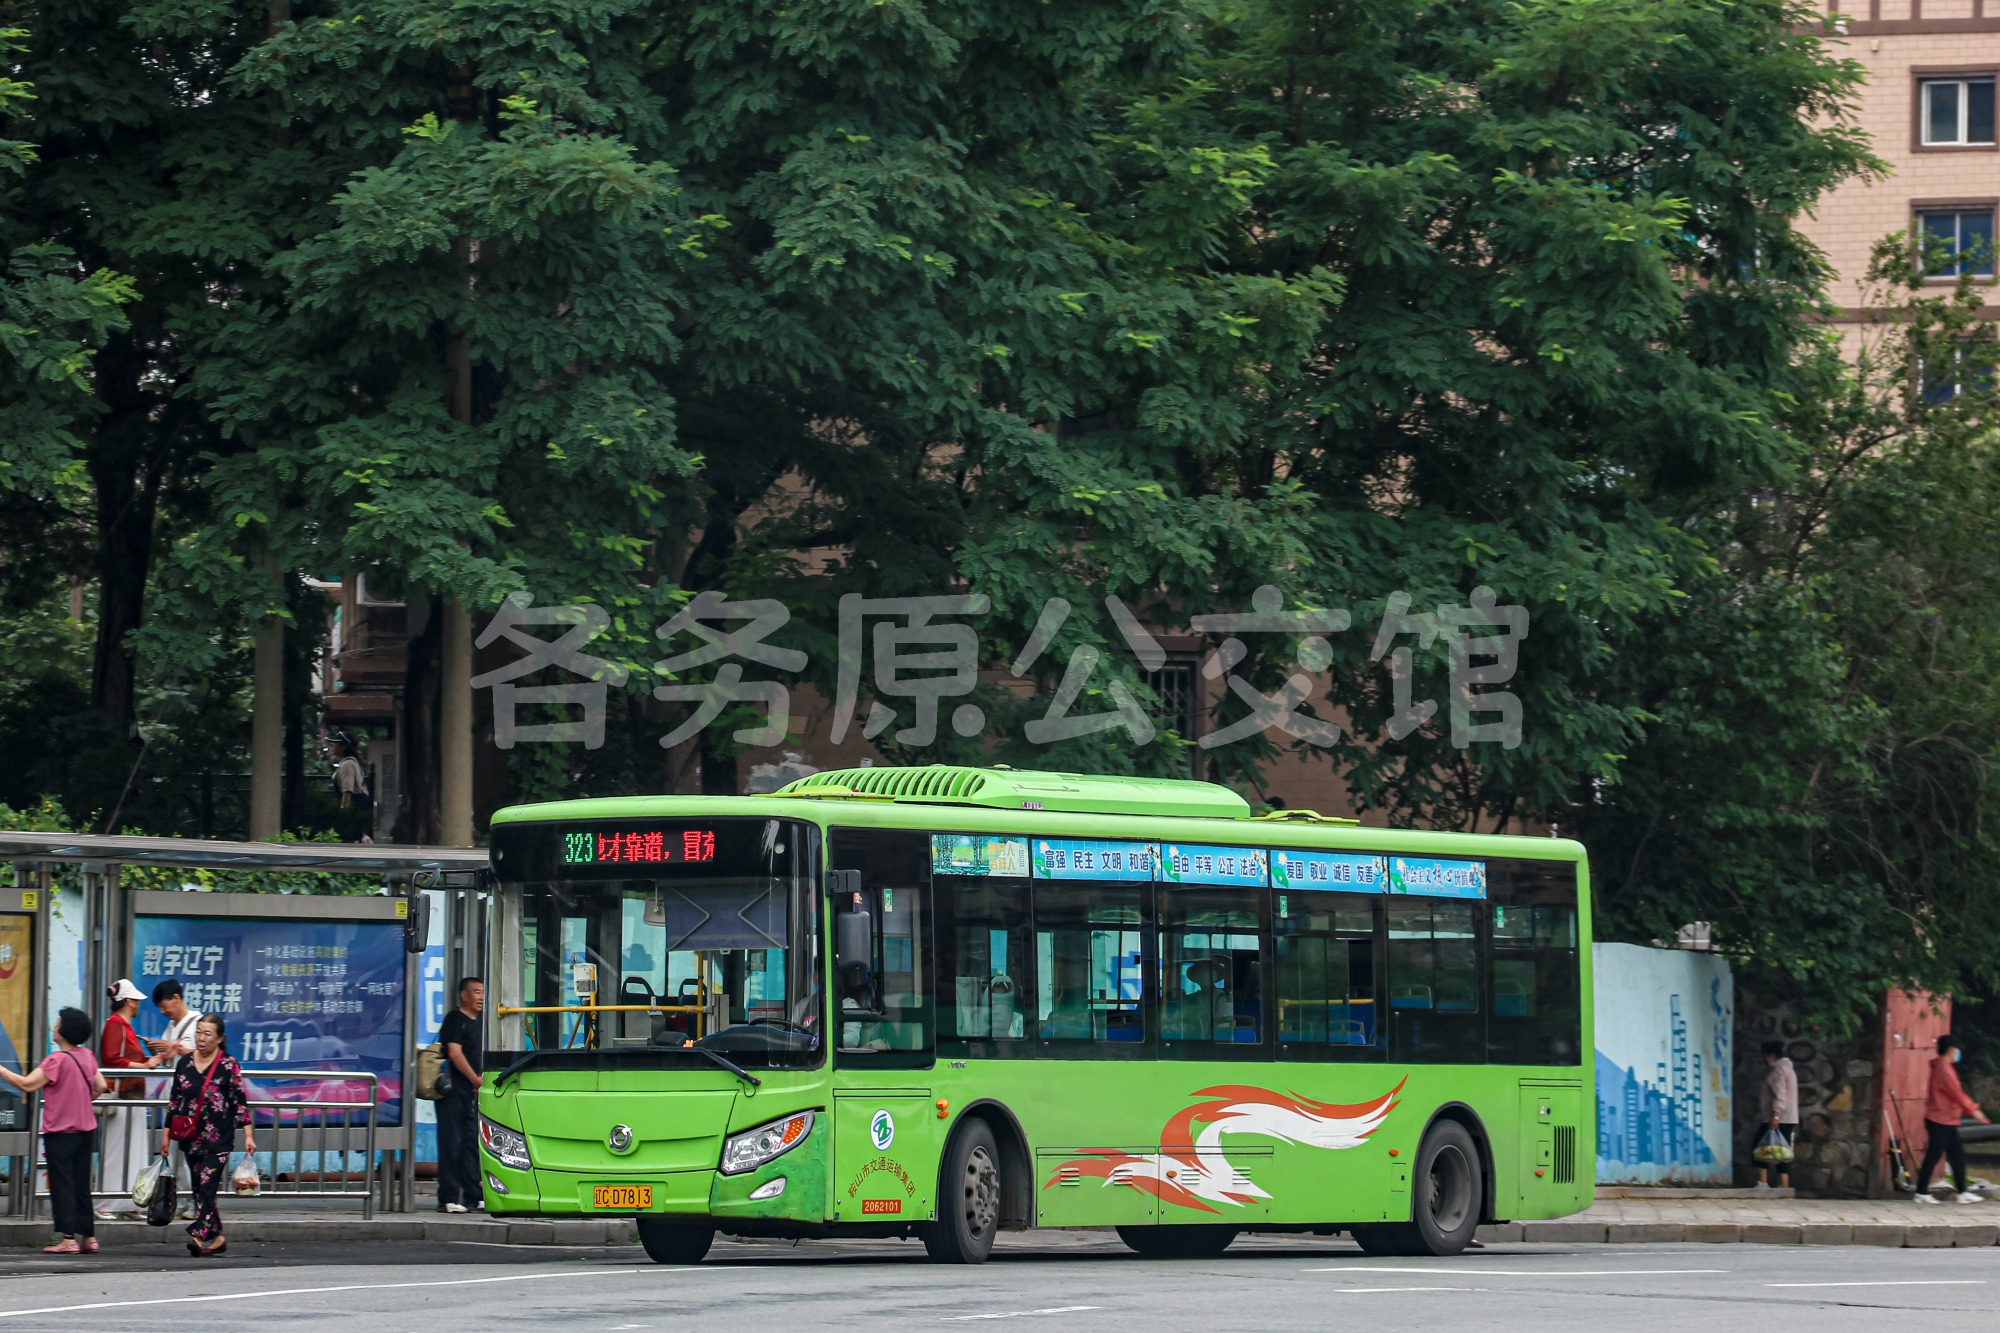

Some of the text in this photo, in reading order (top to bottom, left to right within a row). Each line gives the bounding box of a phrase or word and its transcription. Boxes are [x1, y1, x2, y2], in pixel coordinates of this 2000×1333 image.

[565, 833, 593, 863] 323
[1045, 850, 1066, 869] 富强
[1074, 851, 1094, 869] 民主
[1101, 852, 1121, 870] 文明
[1129, 852, 1149, 871] 和谐
[1173, 855, 1256, 876] 自由 平等 公正 法治
[1286, 861, 1373, 883] 爱国 敬业 诚信 友善
[142, 945, 224, 976] 数字辽宁
[242, 1032, 293, 1061] 1131
[848, 1156, 916, 1198] 鞍山市交通运输集团
[864, 1201, 899, 1212] 2062101
